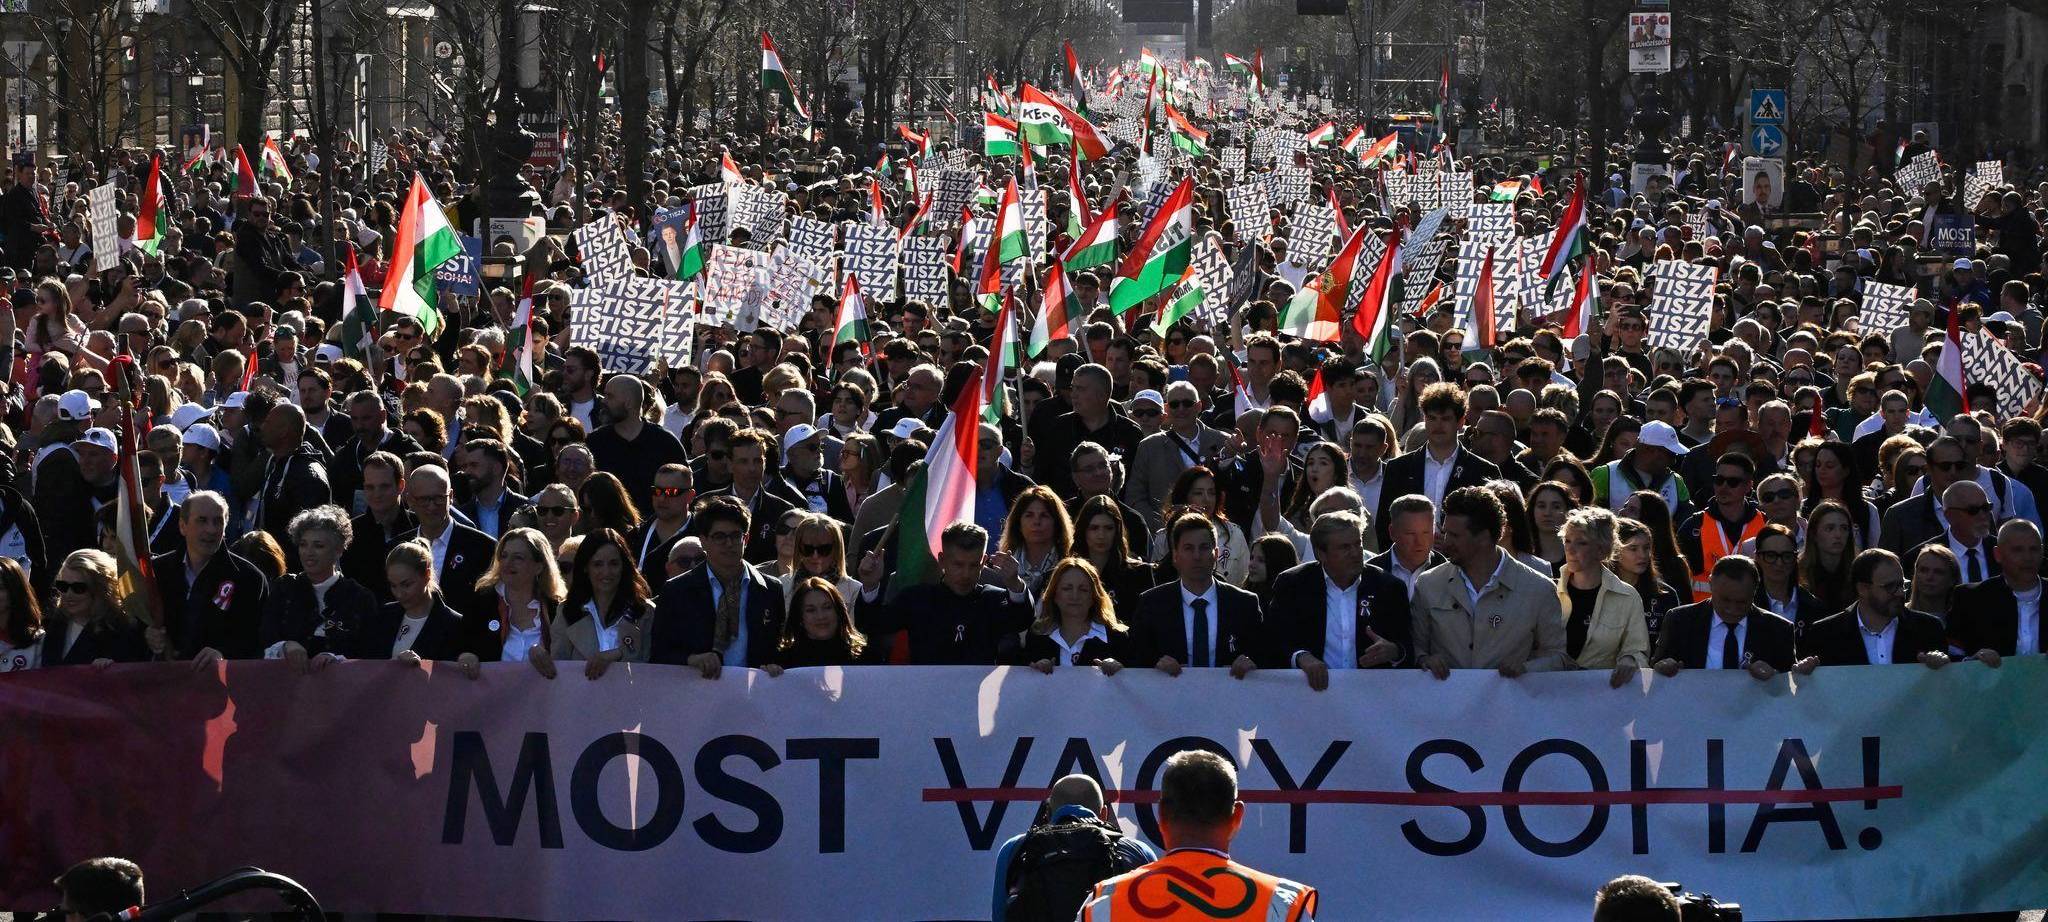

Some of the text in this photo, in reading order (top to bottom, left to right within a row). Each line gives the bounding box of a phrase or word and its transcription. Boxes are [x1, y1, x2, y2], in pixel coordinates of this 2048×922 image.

[1280, 130, 1308, 140] TISZA
[1279, 139, 1308, 149] TISZA
[1279, 147, 1294, 156] TIS
[1277, 155, 1294, 164] TIS
[1911, 149, 1936, 163] TISZA
[1220, 161, 1245, 169] TISZA
[1279, 168, 1312, 176] TISZA
[1914, 158, 1938, 172] TISZA
[1976, 160, 2001, 169] TISZA
[1977, 168, 2002, 176] TISZA
[917, 169, 940, 177] TISZ
[940, 170, 974, 180] TISZA
[1280, 176, 1311, 185] TISZA
[1384, 170, 1406, 179] ISZA
[1407, 174, 1439, 183] TISZA
[1440, 172, 1473, 181] TISZA
[1897, 171, 1917, 186] TISZ
[696, 183, 727, 198] TISZA
[939, 180, 973, 191] TISZA
[1151, 181, 1177, 197] TIS
[1226, 181, 1265, 199] TISZA
[1280, 185, 1310, 194] TISZA
[1387, 179, 1407, 187] SZA
[1388, 187, 1407, 195] SZA
[1407, 183, 1439, 191] TISZA
[1440, 181, 1473, 190] TISZA
[751, 192, 786, 204] TISZA
[938, 190, 973, 202] TISZA
[1227, 193, 1267, 209] TISZA
[1389, 195, 1407, 204] SZA
[1407, 192, 1438, 201] TISZA
[1440, 190, 1473, 200] TISZA
[695, 197, 727, 213] TISZA
[936, 201, 964, 211] TISZ
[1229, 204, 1269, 220] TISZA
[1296, 201, 1337, 218] TISZA
[1419, 201, 1438, 210] SZA
[1468, 203, 1513, 216] TISZA
[668, 209, 686, 218] TISZA
[934, 211, 962, 221] TISZ
[1686, 213, 1706, 223] TISZA
[573, 212, 619, 245] TISZA
[792, 215, 836, 235] TISZA
[1231, 215, 1272, 231] TISZA
[1293, 214, 1335, 231] TISZA
[1468, 217, 1513, 230] TISZA
[1692, 223, 1706, 233] SZA
[700, 226, 727, 241] ISZA
[790, 228, 835, 250] TISZA
[845, 223, 898, 241] TISZA
[1238, 225, 1274, 241] ISZA
[1290, 226, 1333, 244] TISZA
[1692, 233, 1706, 241] SZA
[1938, 228, 1971, 241] MOST
[578, 226, 625, 260] TISZA
[844, 239, 897, 256] TISZA
[903, 236, 946, 250] TISZA
[1288, 239, 1331, 256] TISZA
[1459, 240, 1519, 260] TISZA
[1522, 230, 1557, 254] SZA
[582, 241, 630, 275] TISZA
[843, 254, 897, 271] TISZA
[904, 250, 946, 264] TISZA
[1192, 252, 1226, 278] SZA
[1412, 255, 1439, 270] TISZA
[588, 256, 636, 288] TISZA
[904, 265, 947, 279] TISZA
[1406, 269, 1434, 284] TISZA
[1457, 259, 1518, 278] TIZA
[1657, 259, 1715, 281] TISZA
[436, 270, 472, 284] SOHA!
[842, 270, 896, 287] TSZA
[1201, 266, 1234, 293] SZA
[604, 277, 665, 304] TISZA
[905, 279, 948, 293] TISZA
[1456, 277, 1517, 296] TIZA
[1655, 277, 1713, 299] TISZA
[1863, 280, 1915, 301] TISZA
[572, 288, 603, 304] TIS
[859, 286, 895, 303] SZA
[601, 297, 664, 321] TISZA
[1402, 300, 1421, 313] ISZA
[1455, 295, 1516, 314] TIZA
[1652, 295, 1711, 317] TISZA
[1861, 295, 1904, 314] TISZ
[571, 306, 602, 322] TIS
[1859, 310, 1909, 328] TISZA
[570, 323, 600, 340] TIS
[600, 315, 664, 340] TISZA
[1650, 313, 1709, 335] TISZA
[598, 334, 660, 358] TISZA
[1961, 327, 1993, 368] SZA
[1967, 340, 2005, 384] ISZA
[1984, 350, 2019, 390] SZA
[1996, 363, 2031, 407] SZA
[2002, 376, 2043, 421] ISZA
[442, 731, 879, 854] MOST
[1400, 736, 1883, 858] SOHA!
